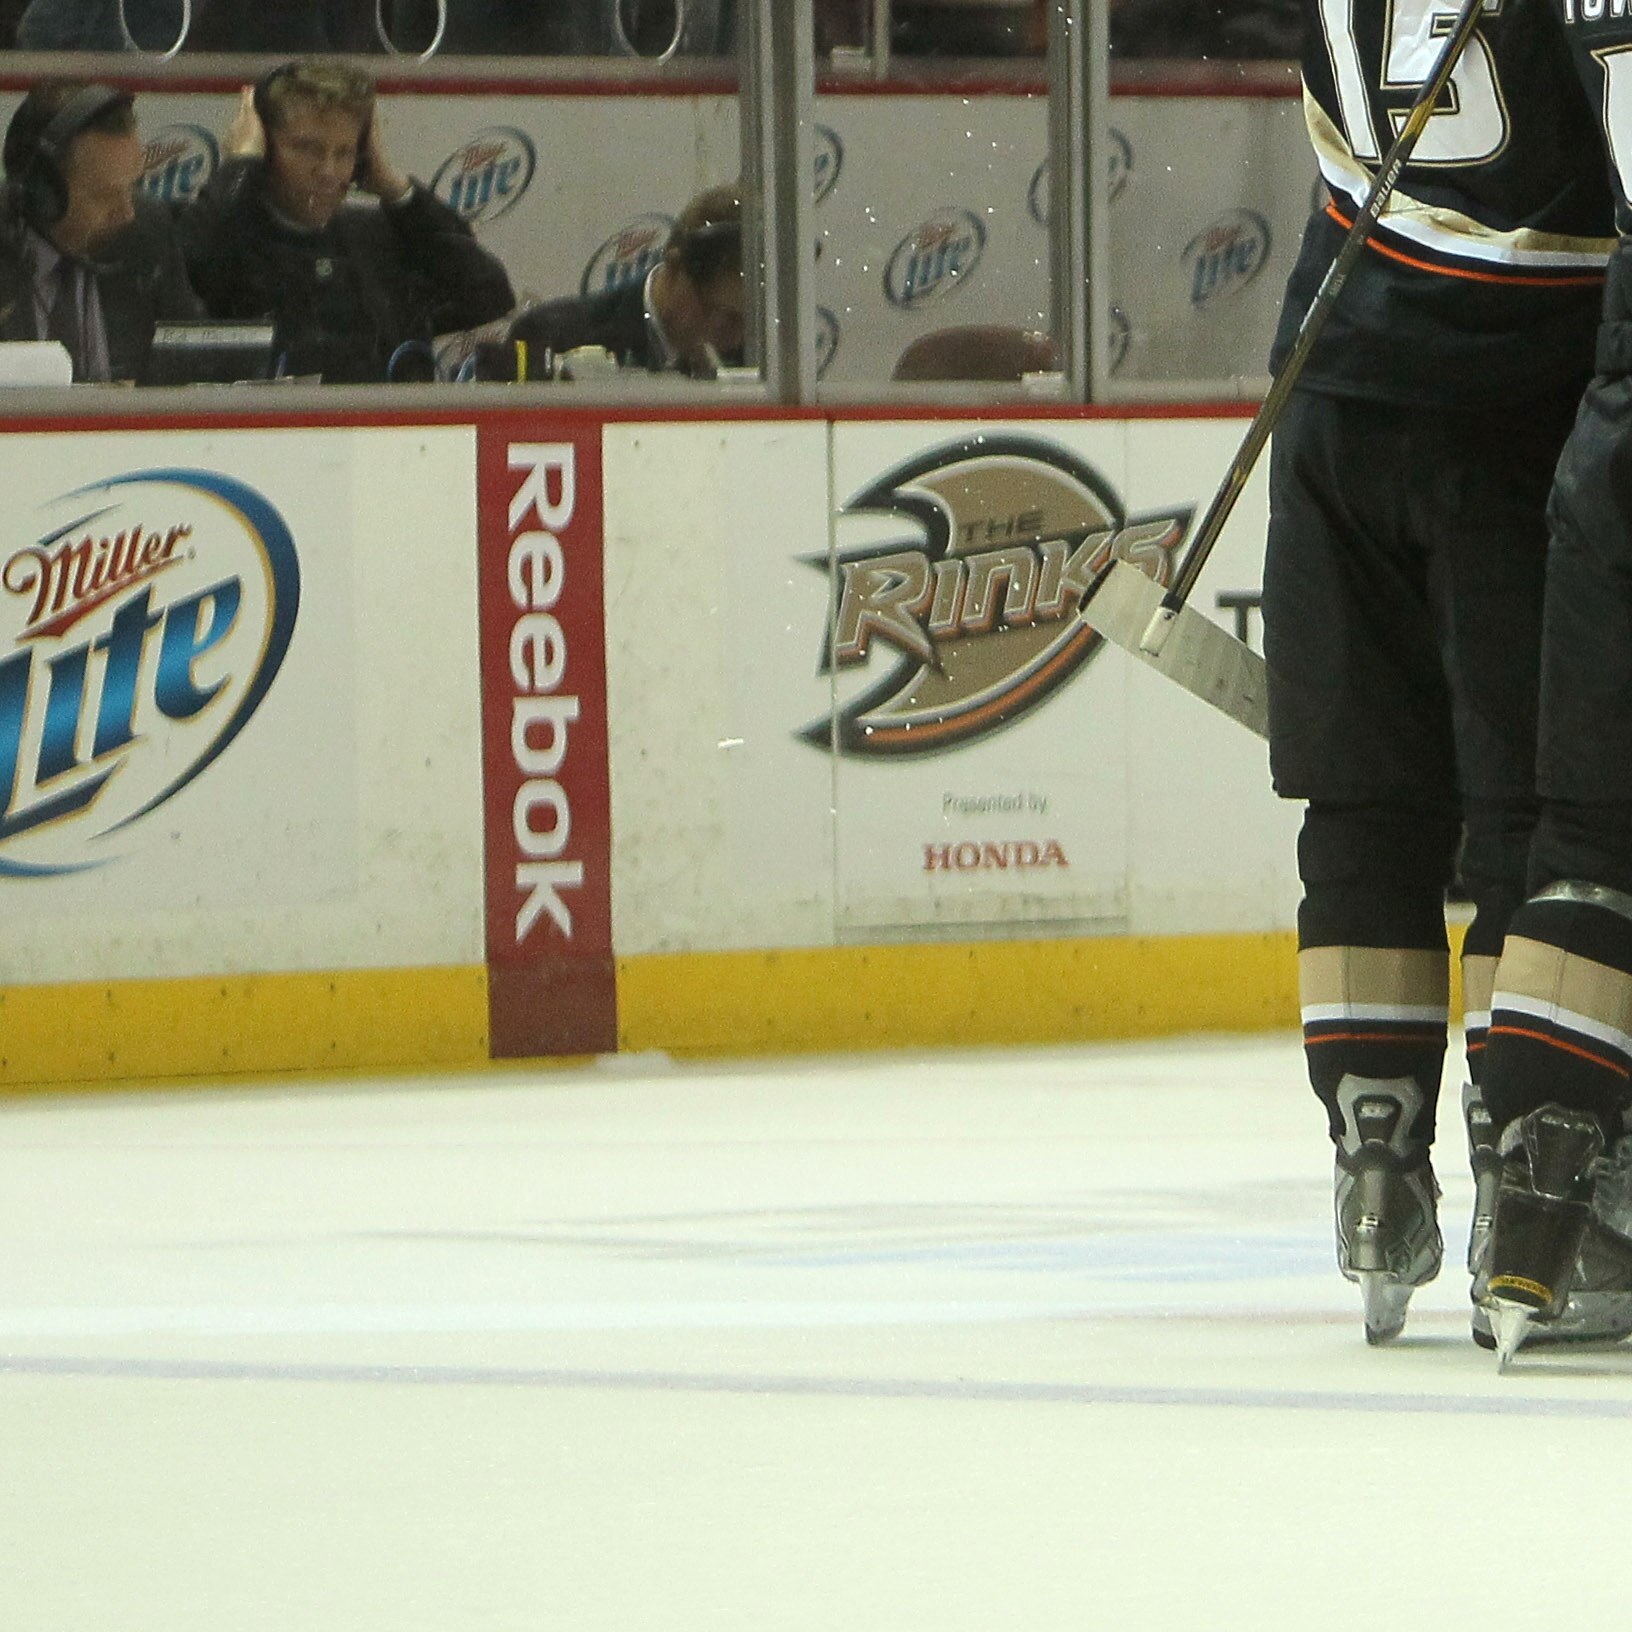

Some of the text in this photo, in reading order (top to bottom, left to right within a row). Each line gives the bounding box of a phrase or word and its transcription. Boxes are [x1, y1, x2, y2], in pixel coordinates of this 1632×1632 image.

[961, 511, 1044, 542] THE
[3, 523, 192, 625] Miller
[506, 442, 583, 944] Reebok
[923, 840, 1070, 871] HONDA
